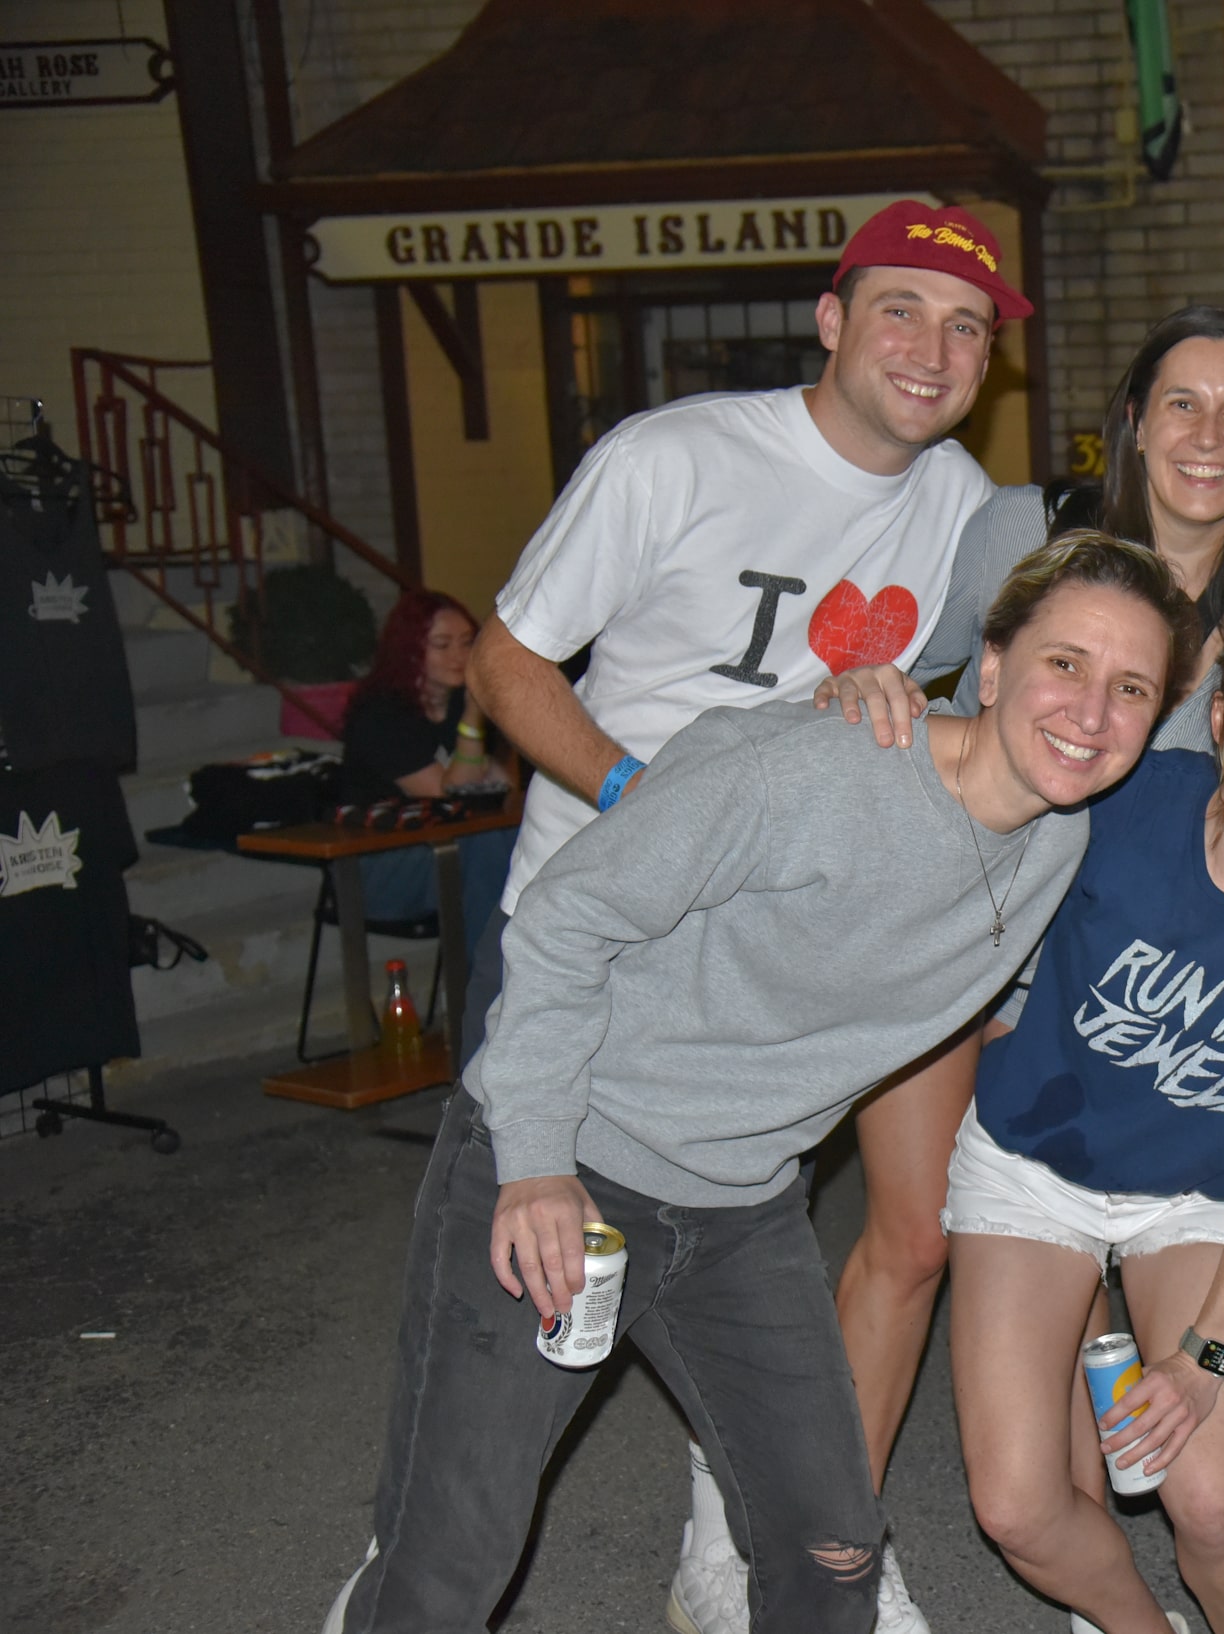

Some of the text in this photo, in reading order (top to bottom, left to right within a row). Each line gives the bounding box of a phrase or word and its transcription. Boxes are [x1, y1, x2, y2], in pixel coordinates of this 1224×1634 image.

[36, 53, 99, 77] ROSE
[385, 206, 847, 265] GRANDE ISLAND
[708, 569, 807, 688] I
